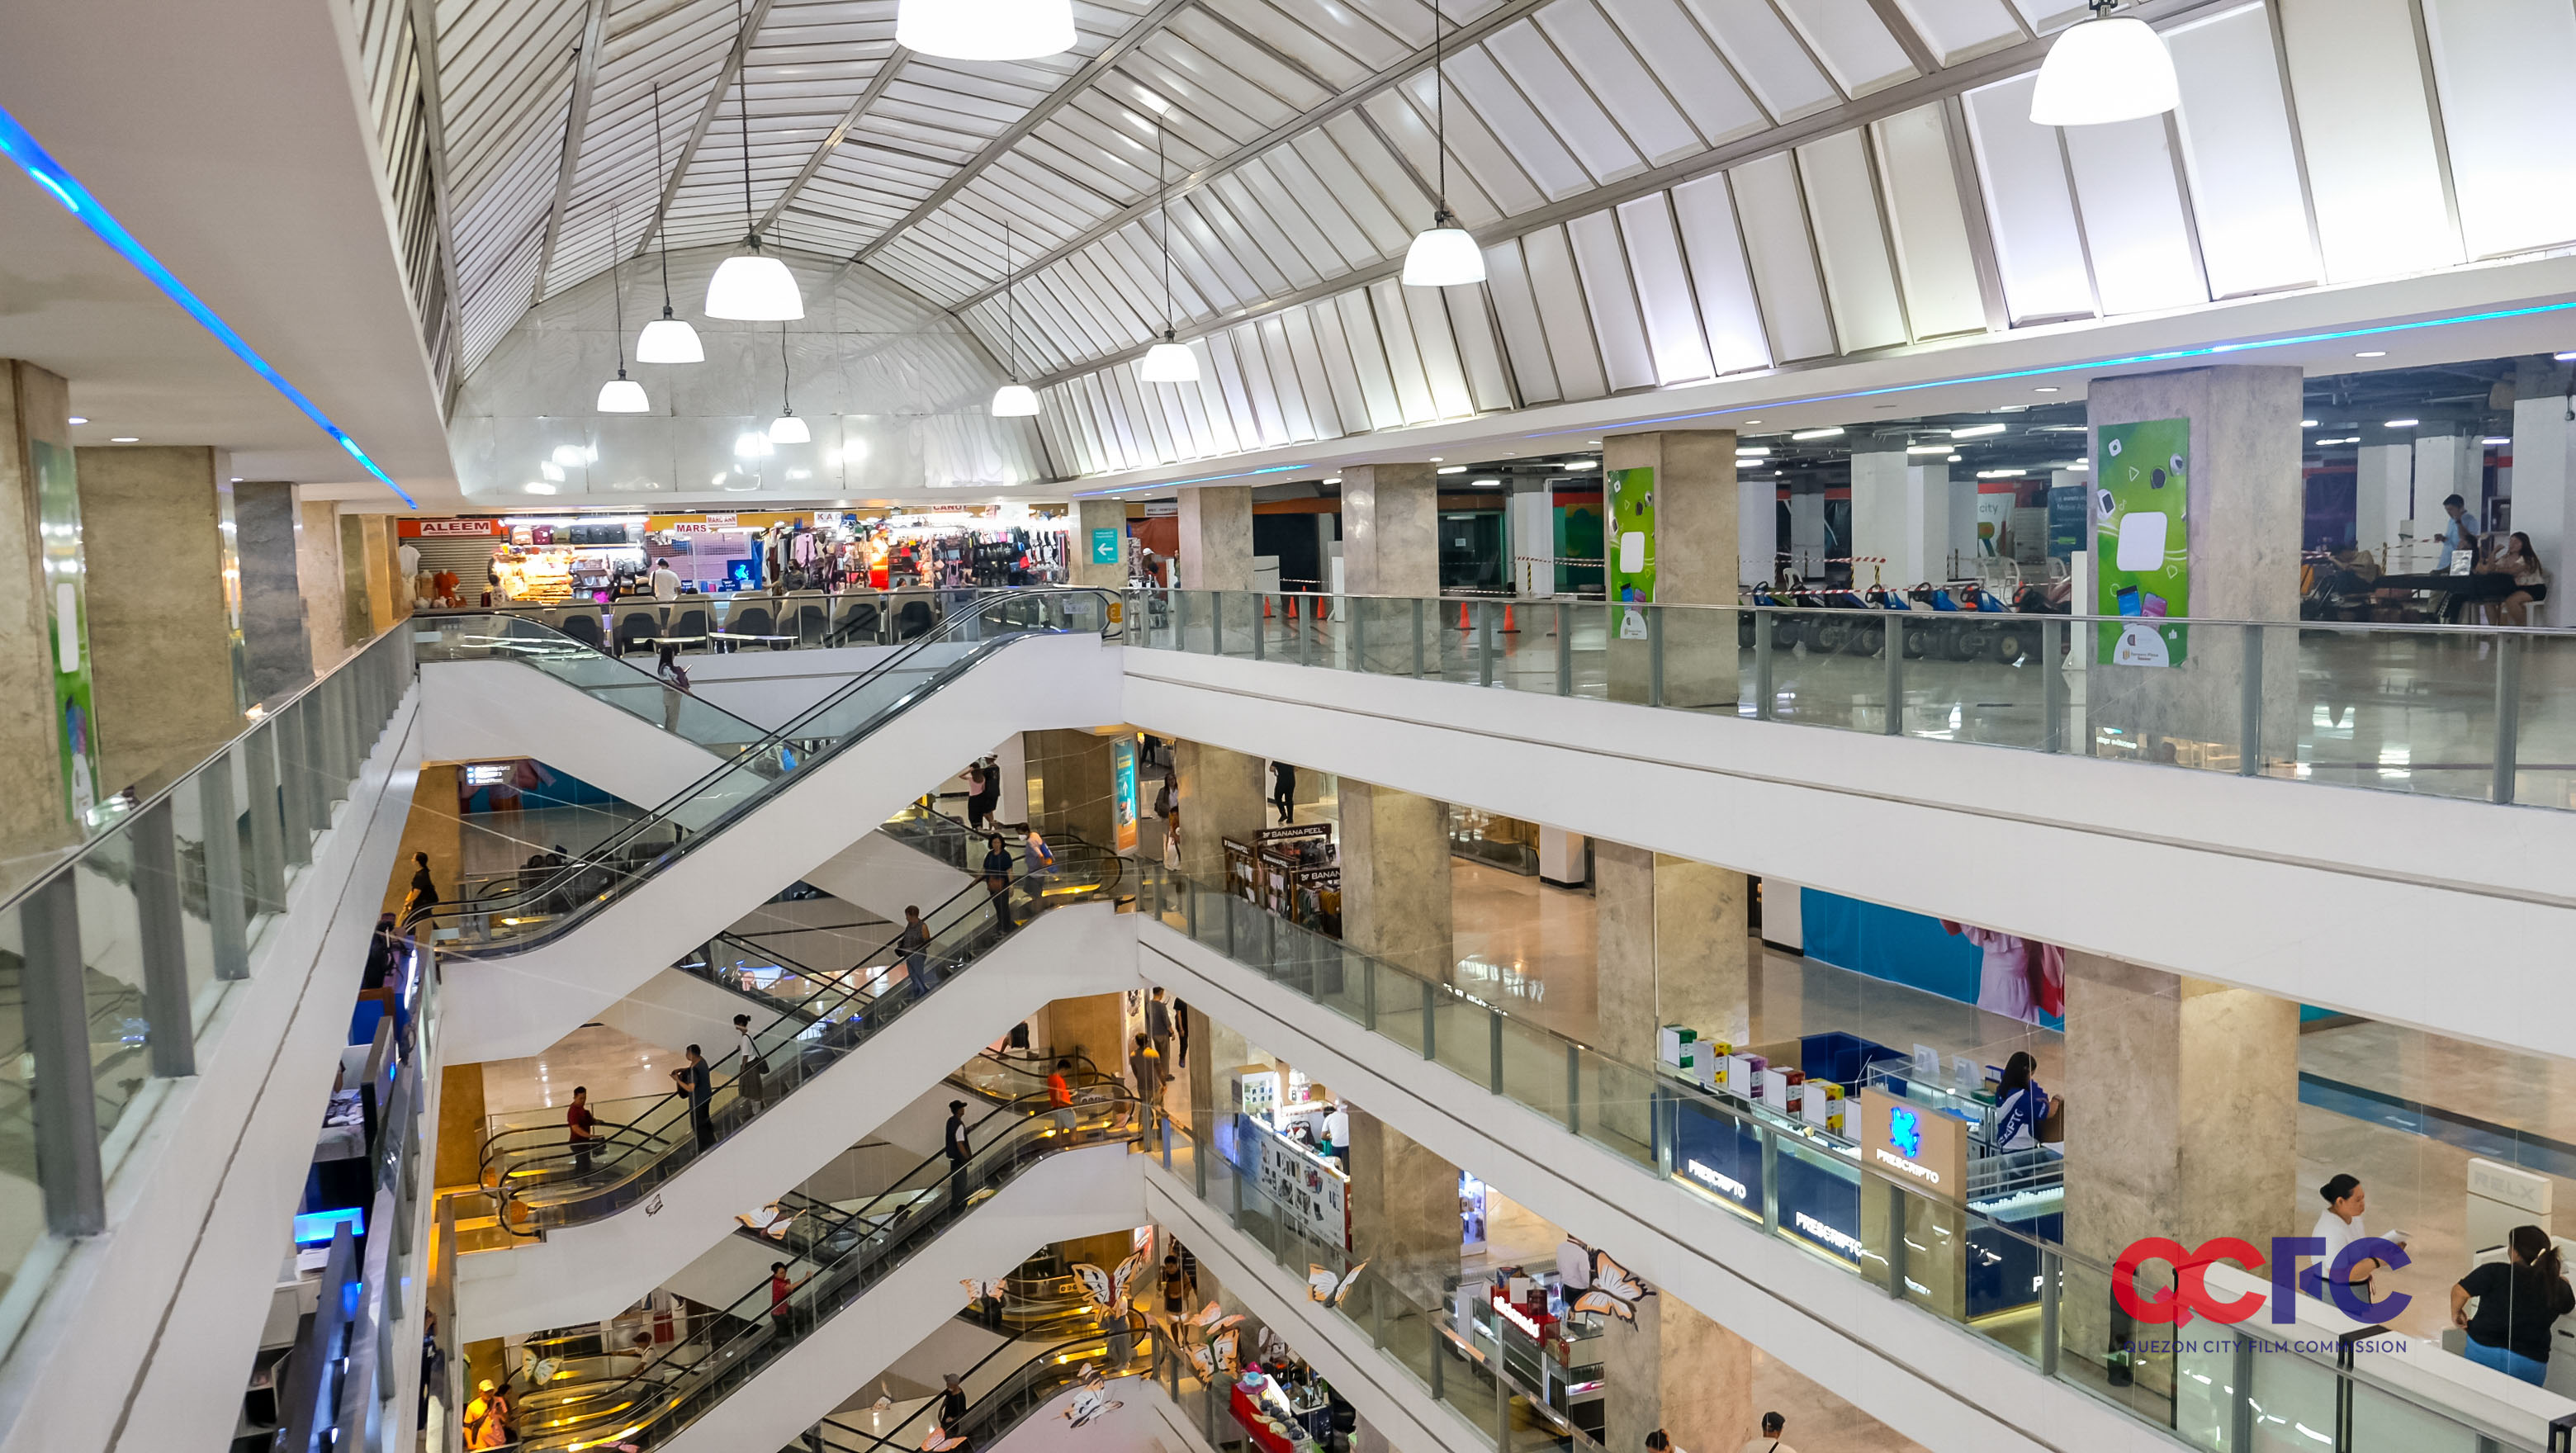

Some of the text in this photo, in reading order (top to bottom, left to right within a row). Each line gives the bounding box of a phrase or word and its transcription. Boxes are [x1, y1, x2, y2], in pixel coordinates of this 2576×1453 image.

[423, 522, 490, 532] ALEEM
[676, 523, 707, 532] MARS
[1305, 827, 1324, 835] PEEL
[1876, 1148, 1940, 1184] PRESCRIPTO
[1688, 1158, 1747, 1200] PRESCRIPTO
[2474, 1170, 2536, 1204] RELX
